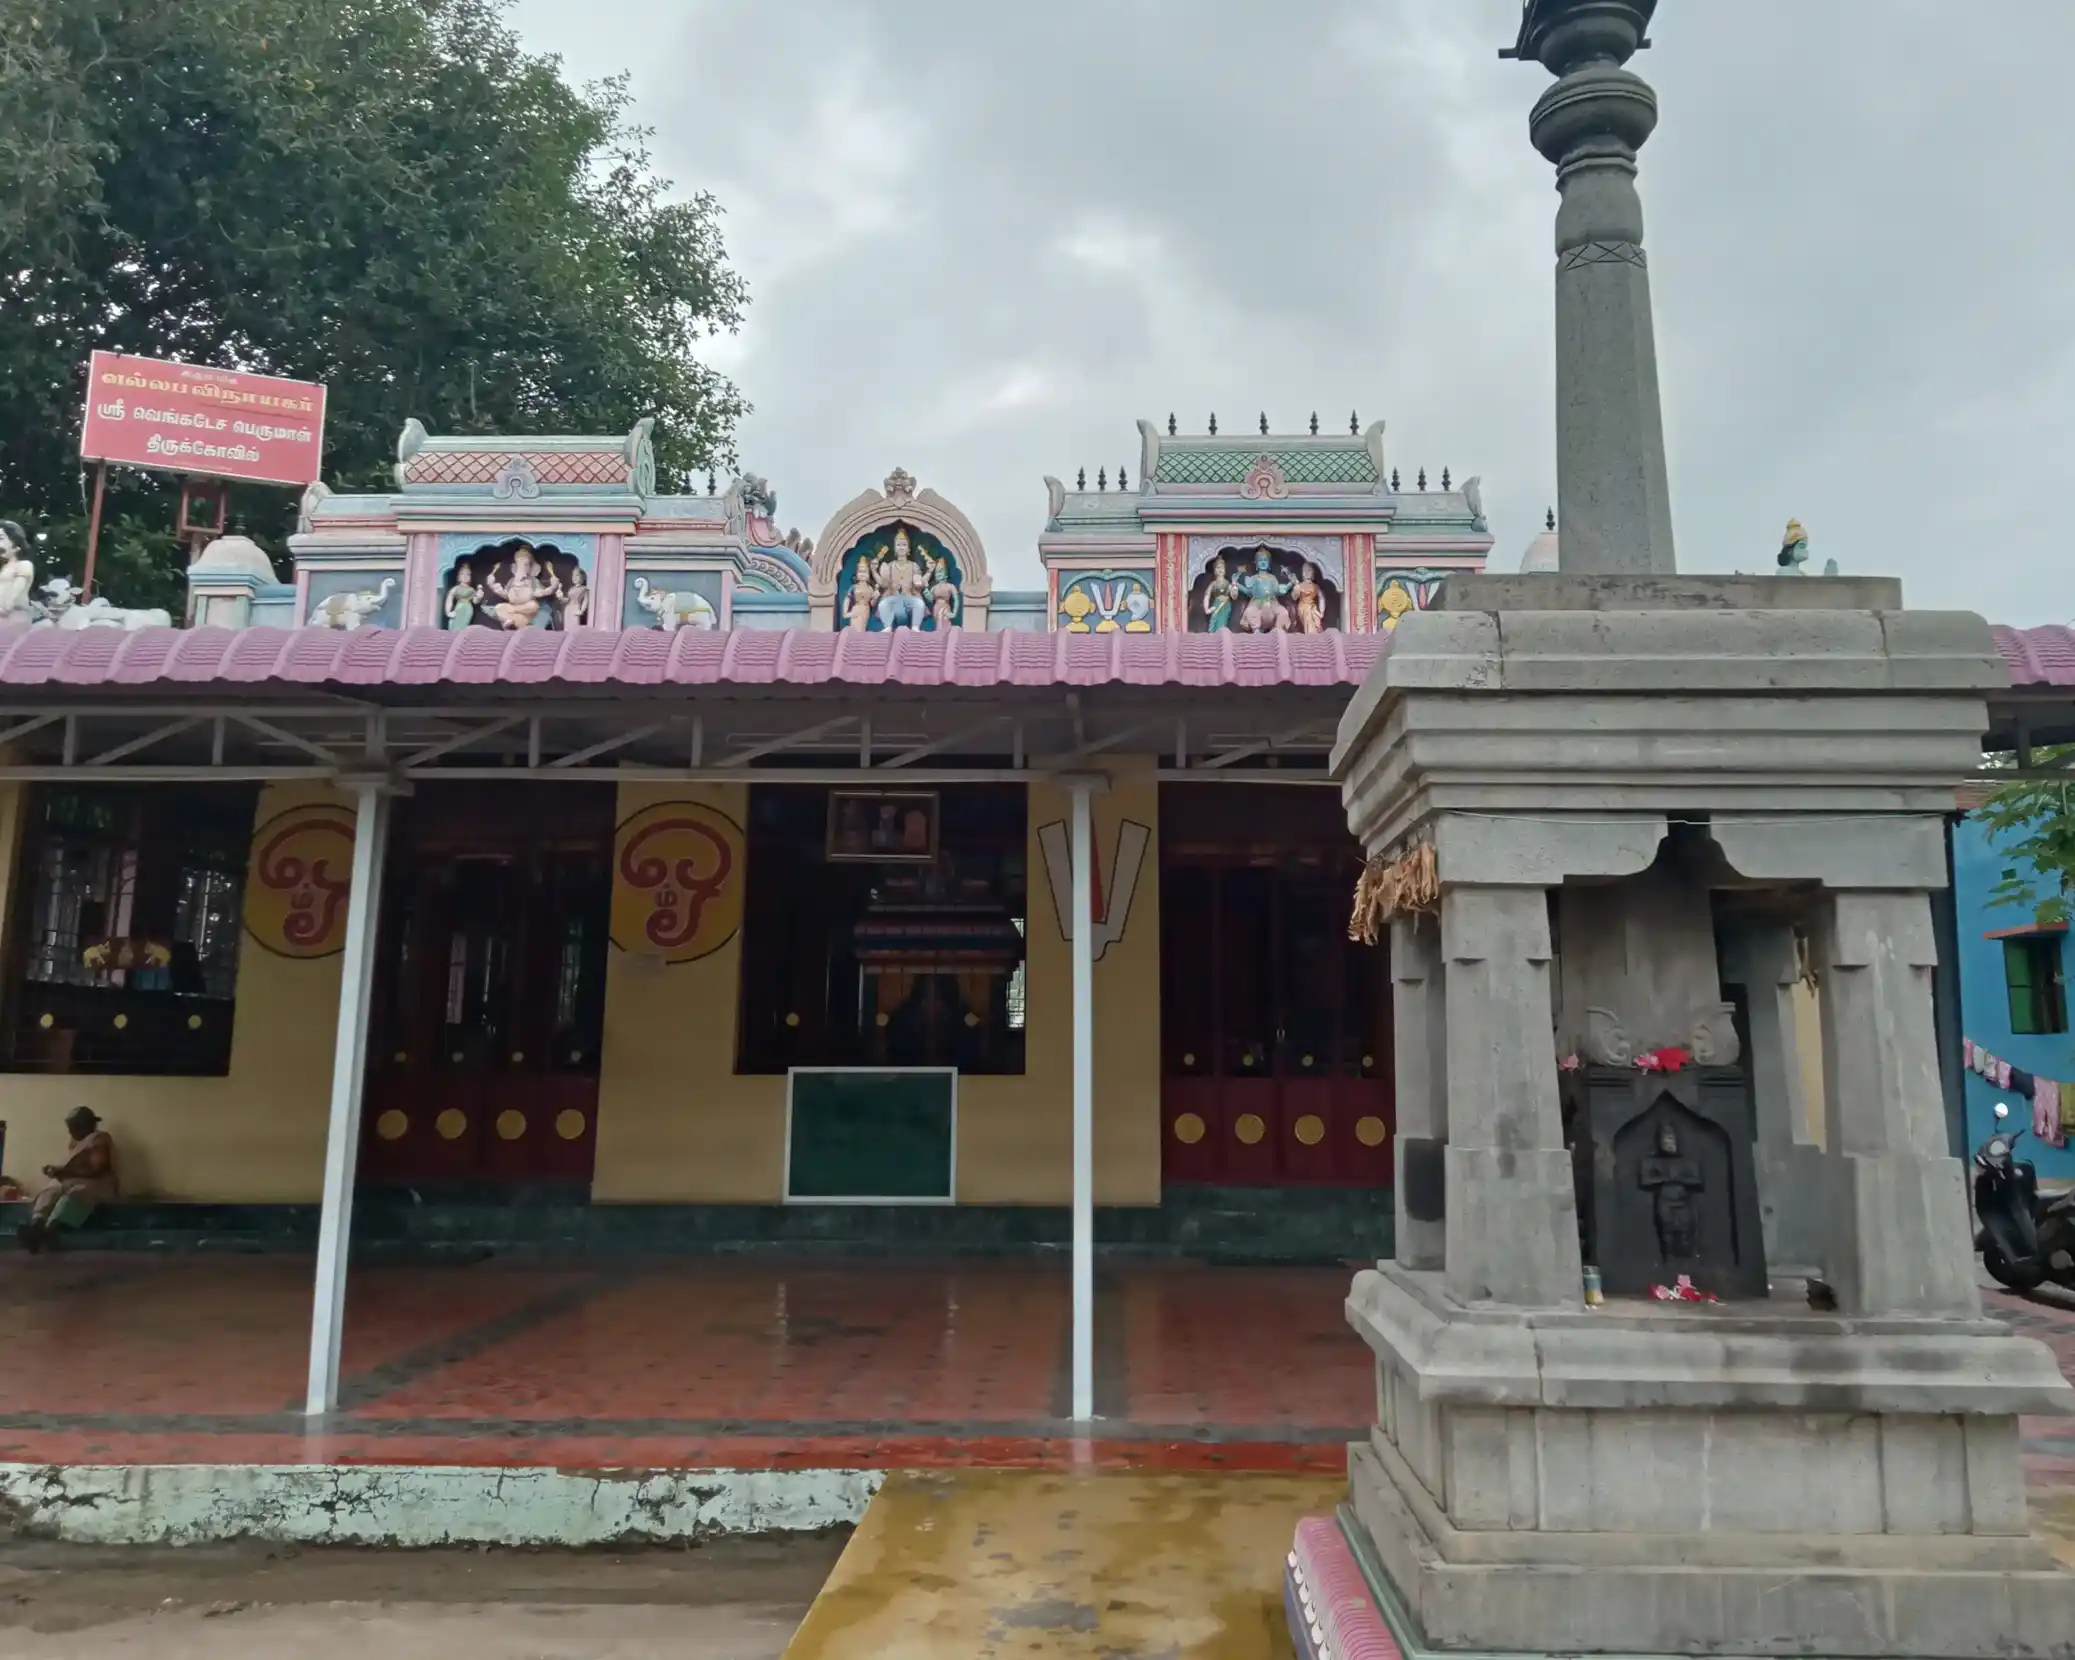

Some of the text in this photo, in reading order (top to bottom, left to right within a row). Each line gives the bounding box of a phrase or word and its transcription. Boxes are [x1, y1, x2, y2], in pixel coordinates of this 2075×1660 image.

[133, 406, 229, 430] வெங்கடேச
[232, 419, 312, 443] பெருமாள்
[146, 433, 260, 462] திருக்கோவில்
